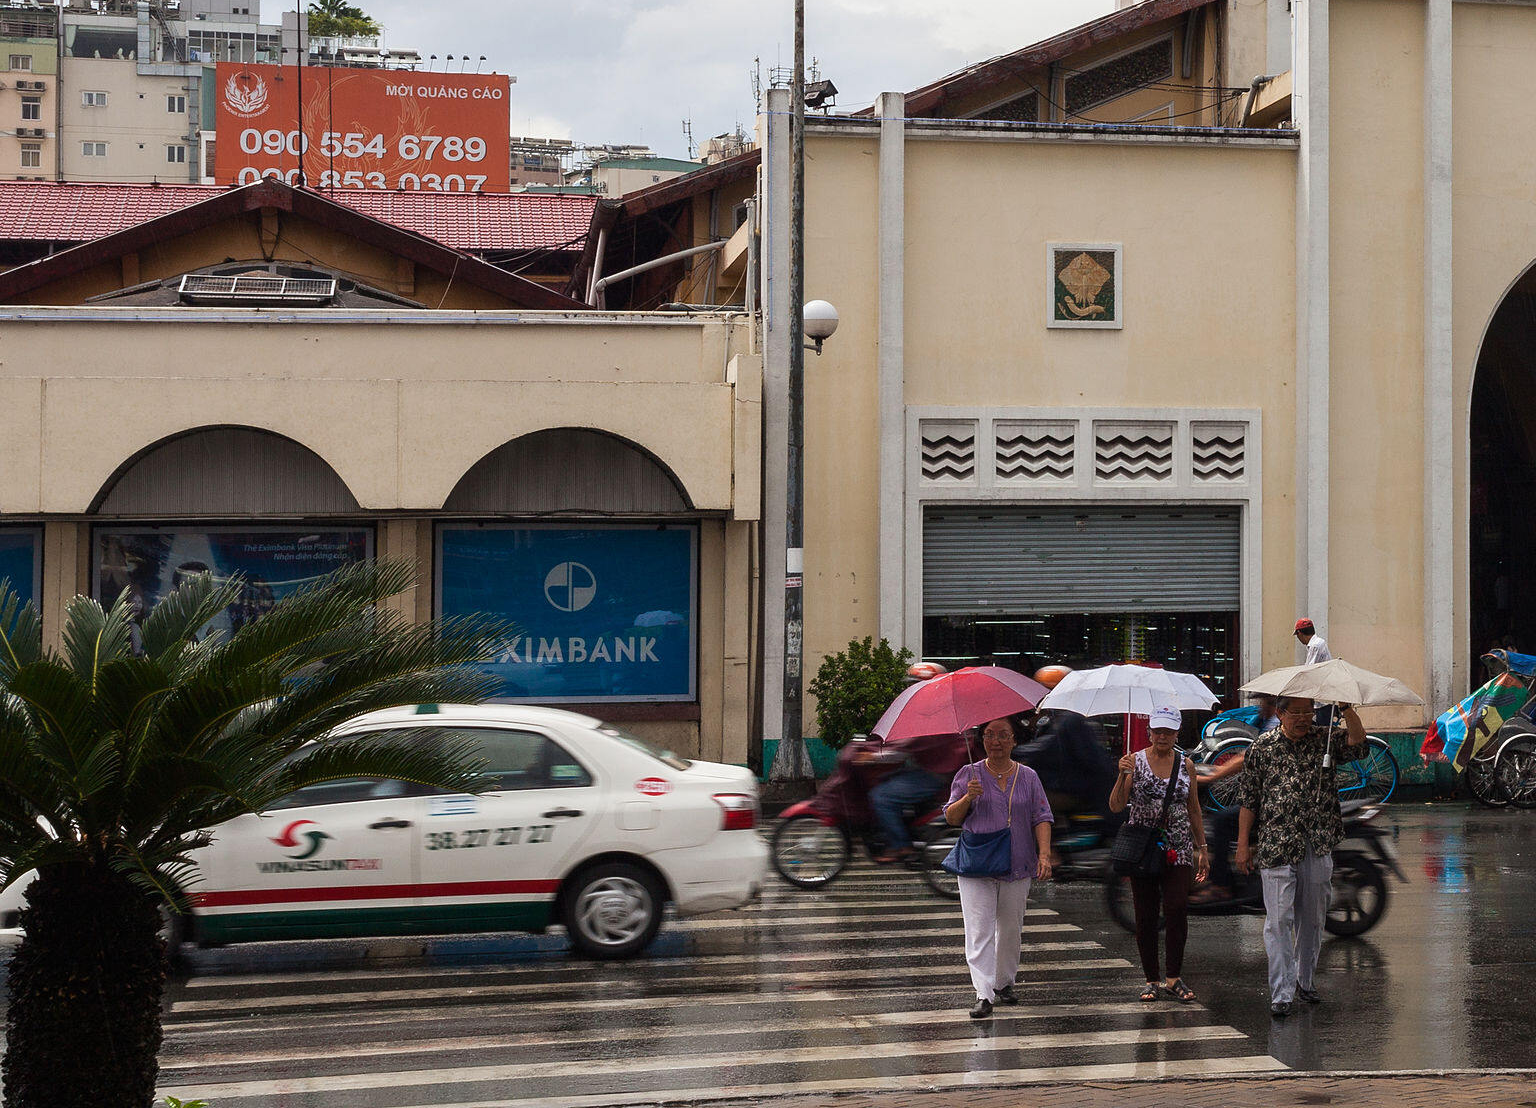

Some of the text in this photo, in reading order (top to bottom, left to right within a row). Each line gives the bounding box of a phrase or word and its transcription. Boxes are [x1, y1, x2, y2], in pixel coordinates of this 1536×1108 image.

[386, 83, 503, 100] MỜI QUẢNG CÁO
[240, 128, 487, 163] 090 554 6789
